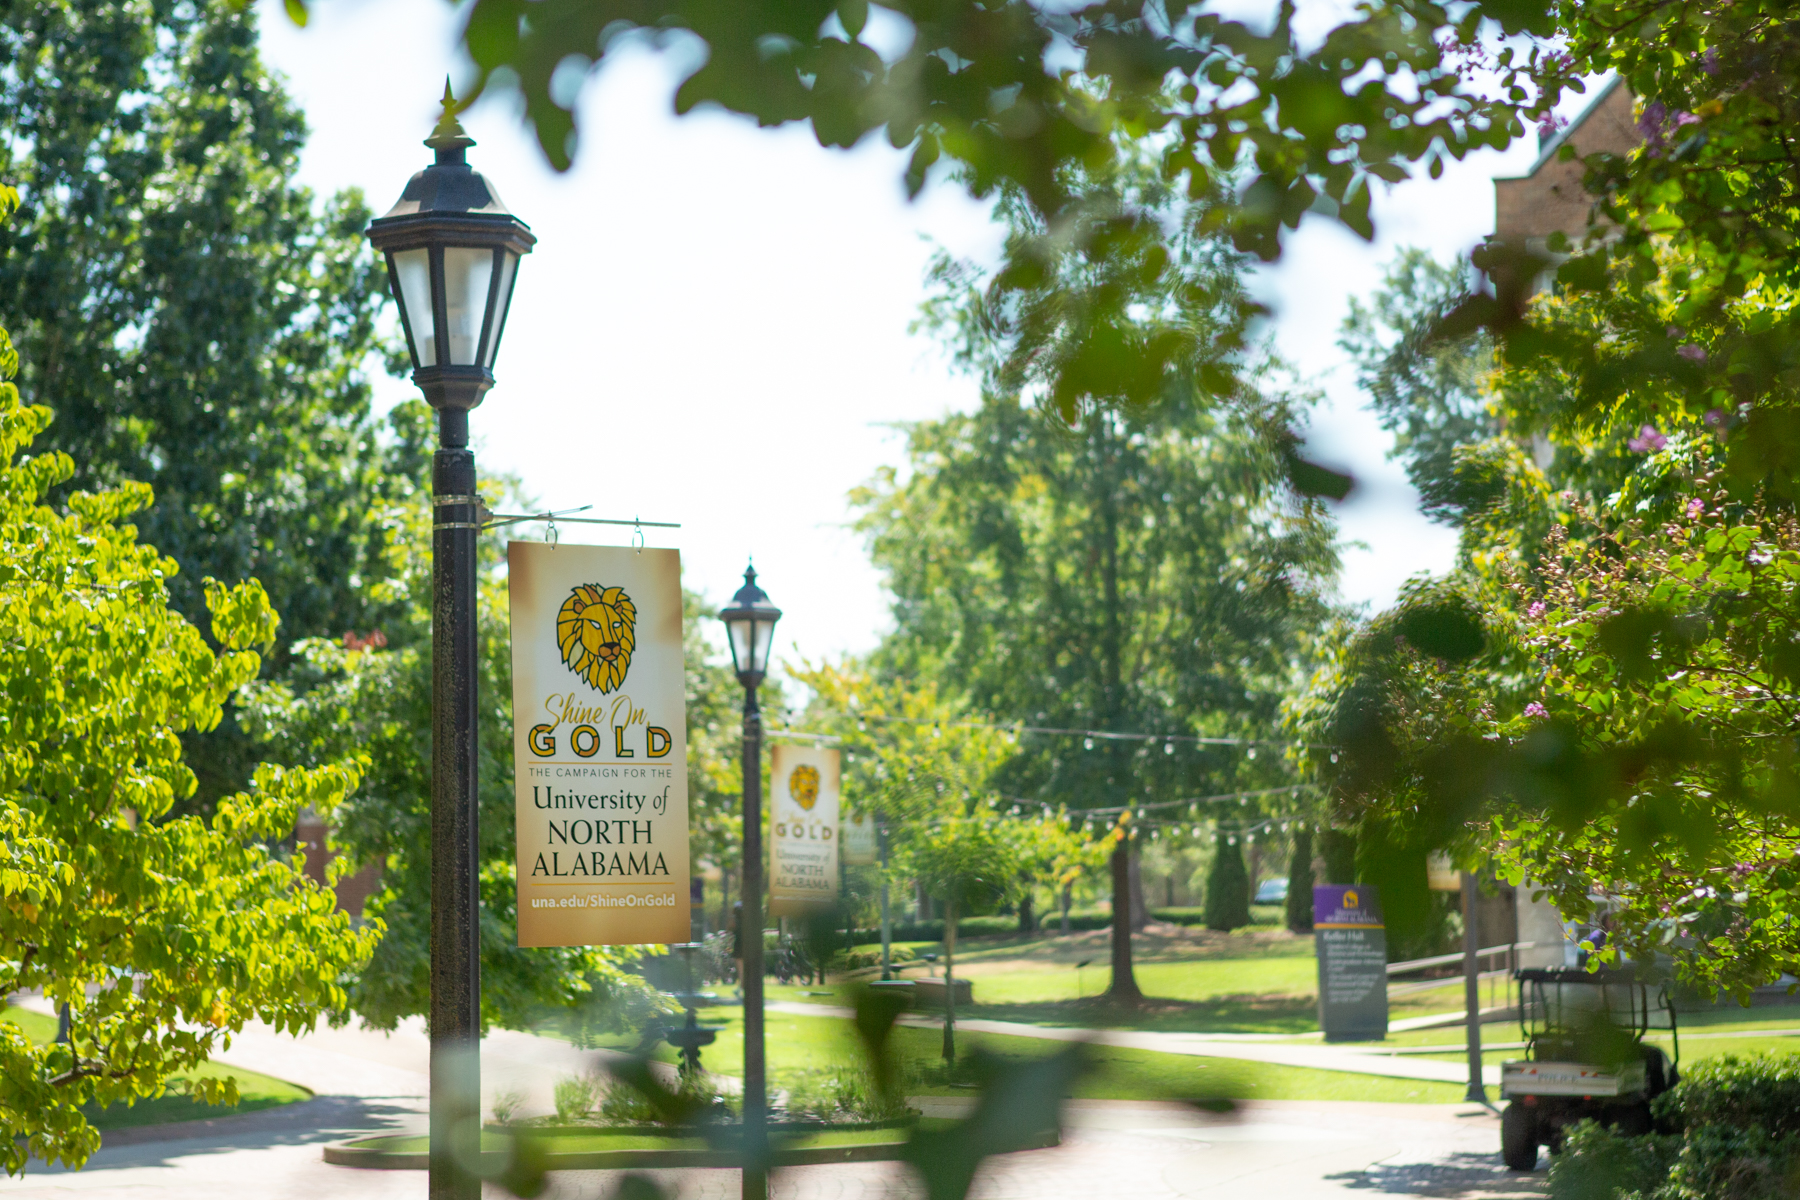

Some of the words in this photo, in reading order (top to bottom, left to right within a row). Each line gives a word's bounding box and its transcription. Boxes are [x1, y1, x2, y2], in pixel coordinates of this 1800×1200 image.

[541, 692, 606, 733] Shine
[611, 694, 650, 734] On
[528, 723, 672, 758] GOLD
[529, 767, 551, 777] THE
[556, 768, 619, 778] CAMPAIGN
[624, 768, 646, 778] FOR
[652, 769, 672, 778] THE
[532, 785, 646, 814] University
[652, 785, 671, 815] of
[548, 819, 652, 845] NORTH
[775, 822, 832, 840] GOLD
[531, 851, 670, 876] ALABAMA
[780, 864, 824, 877] NORTH
[774, 876, 830, 890] ALABAMA
[531, 893, 675, 908] una.edu/ShineOnGold
